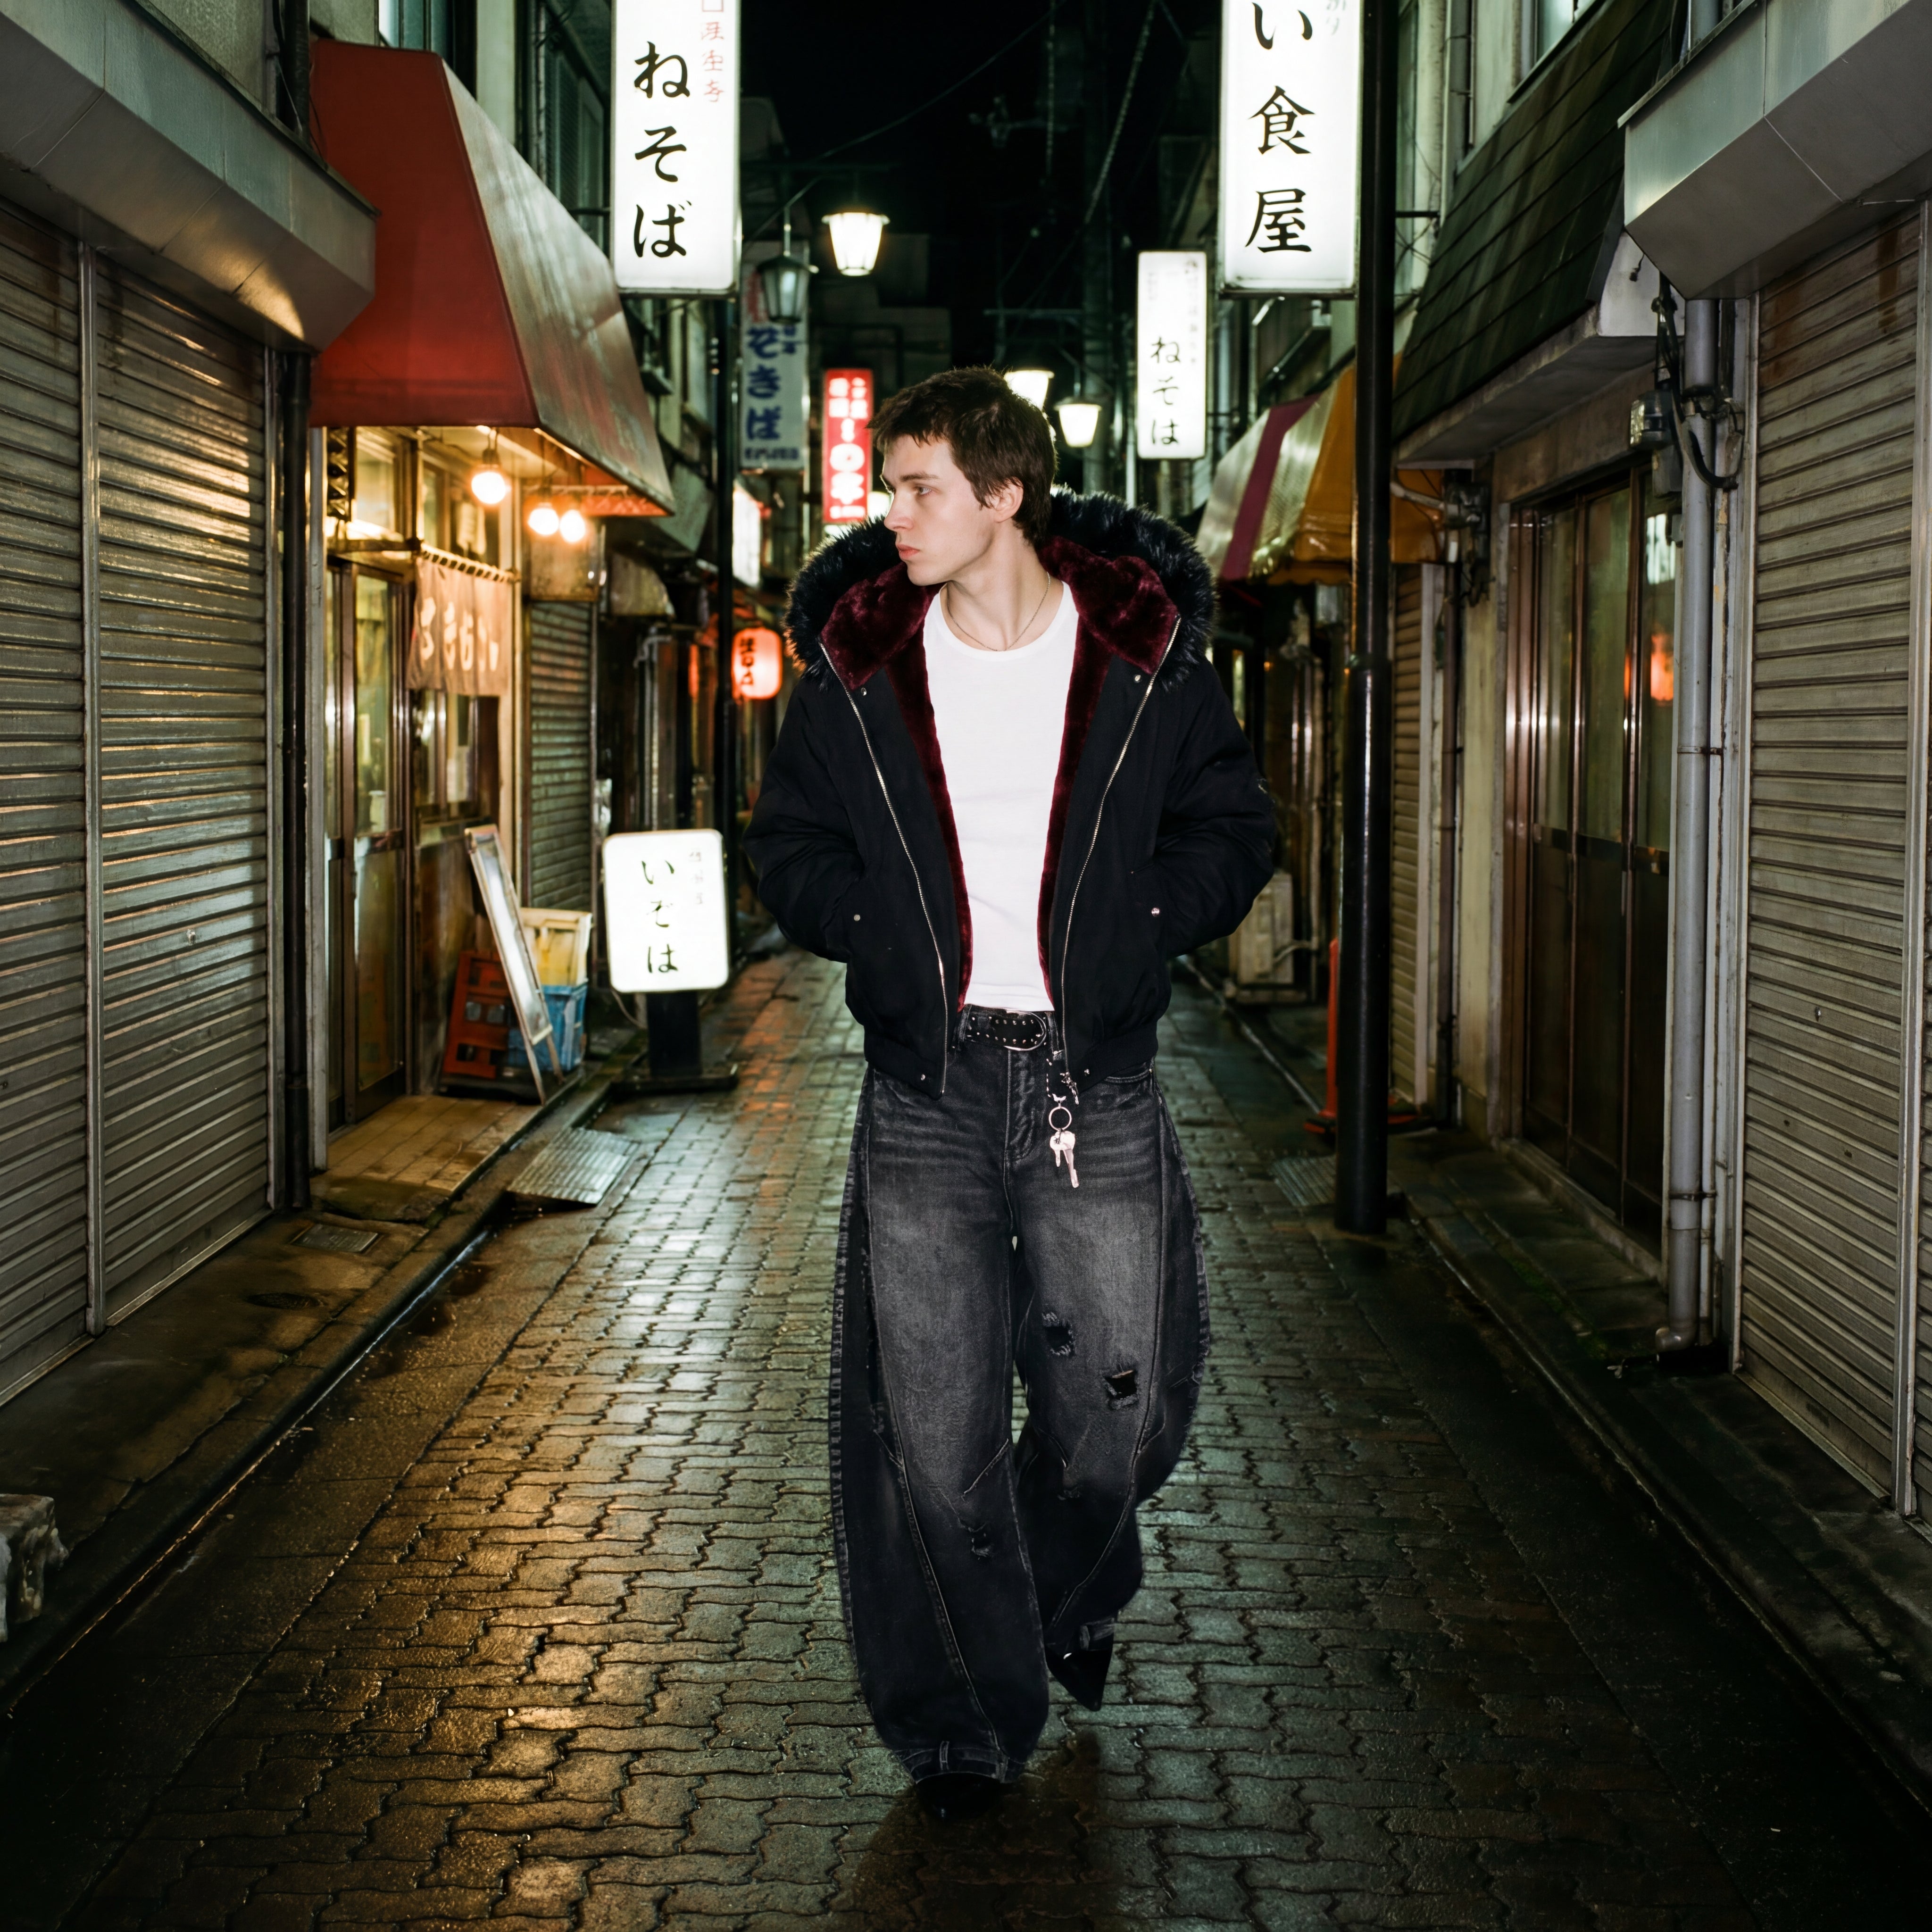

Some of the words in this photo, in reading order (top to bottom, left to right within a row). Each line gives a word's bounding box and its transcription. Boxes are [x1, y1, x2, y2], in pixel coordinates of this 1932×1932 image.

[634, 41, 692, 258] ねそば
[1245, 2, 1316, 253] い食屋
